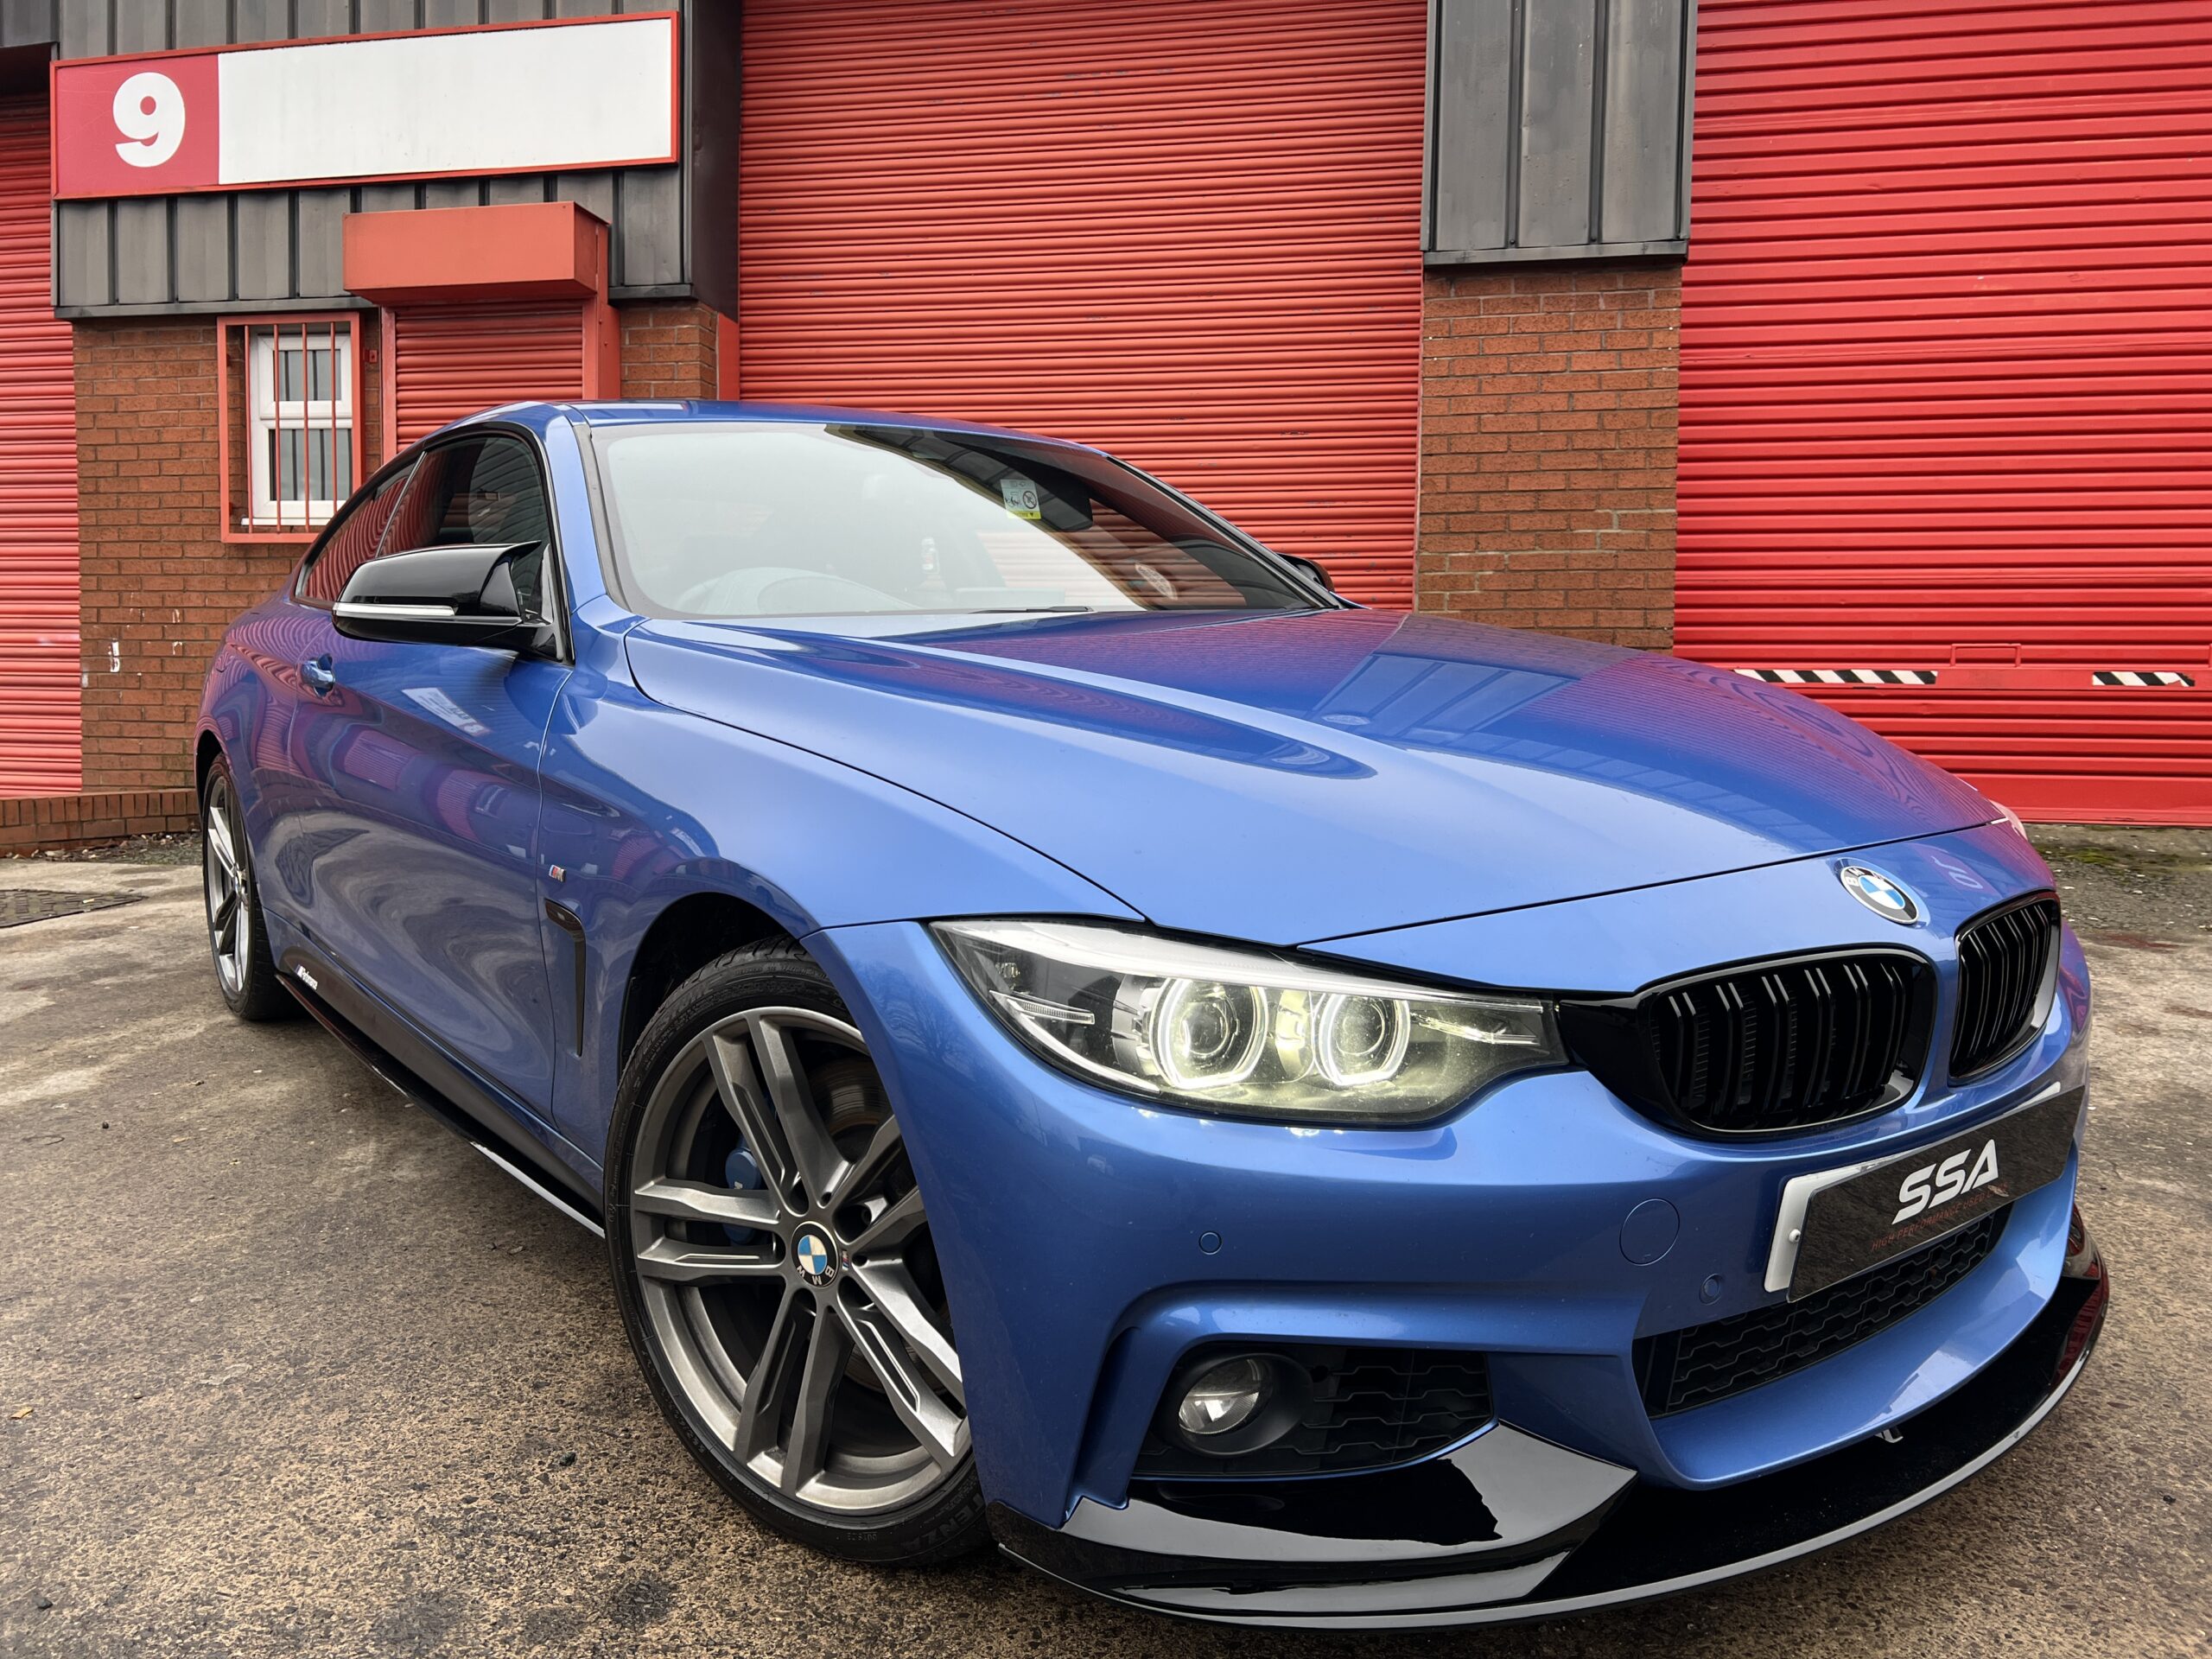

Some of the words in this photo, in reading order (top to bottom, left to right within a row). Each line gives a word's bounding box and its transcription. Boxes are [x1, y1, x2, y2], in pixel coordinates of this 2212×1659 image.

[112, 71, 186, 168] 9
[1891, 1138, 1999, 1225] SSA
[1871, 1233, 1897, 1251] HIGH
[1897, 1202, 1962, 1239] PERFORMANCE
[1962, 1192, 1986, 1211] USED
[796, 1264, 836, 1286] BMW
